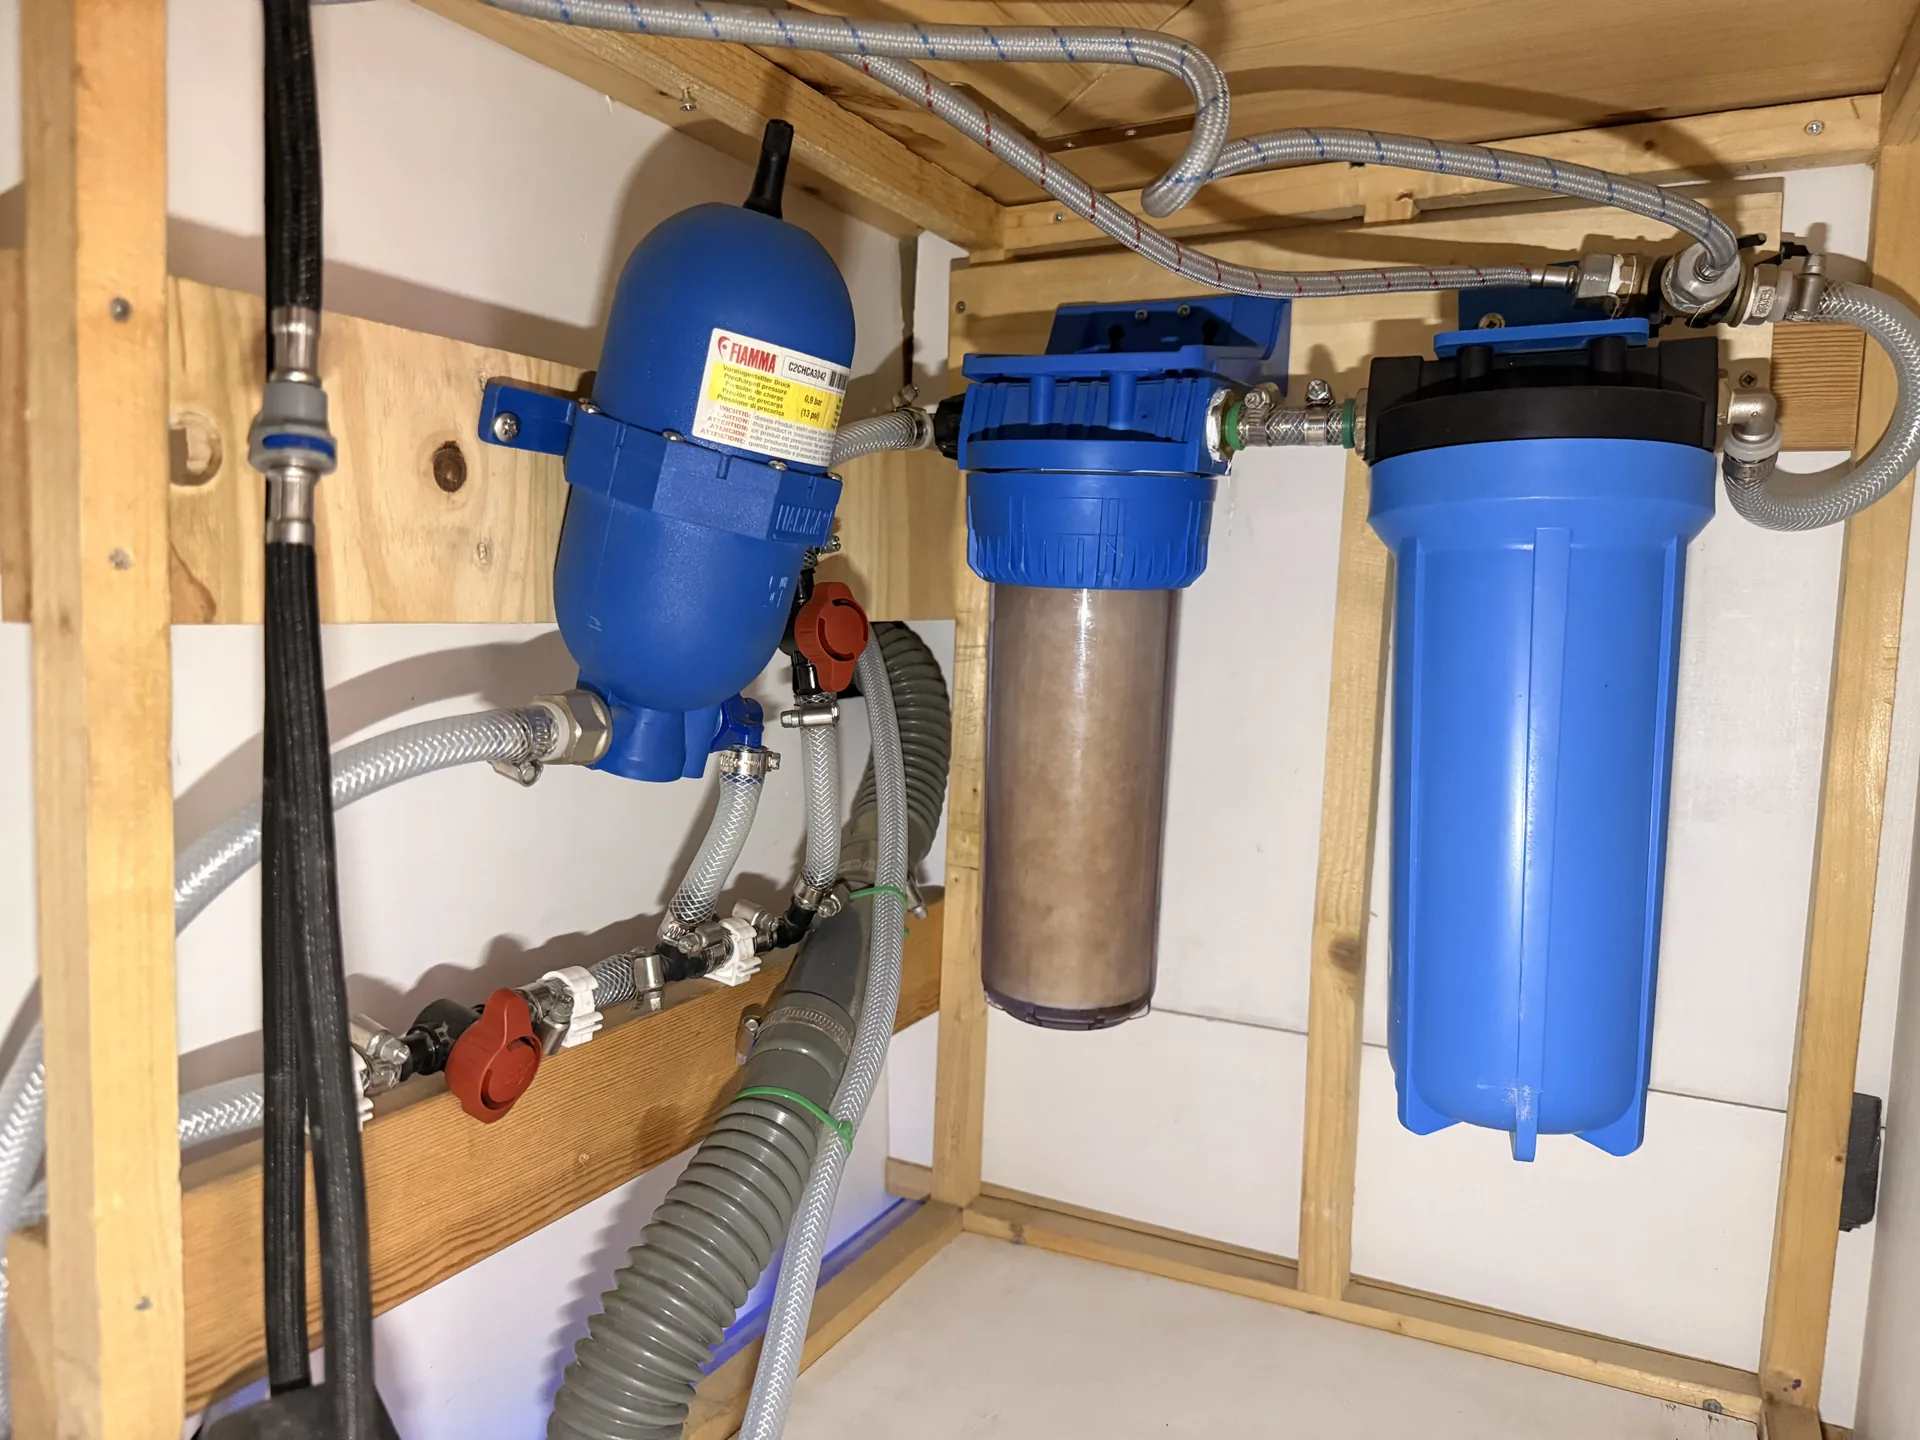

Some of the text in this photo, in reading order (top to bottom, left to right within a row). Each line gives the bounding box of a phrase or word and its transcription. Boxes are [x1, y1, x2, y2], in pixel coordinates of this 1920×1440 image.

[730, 342, 777, 374] FIAMMA
[724, 372, 787, 396] Precharged pressure
[725, 381, 752, 393] Pression
[763, 391, 784, 402] charge
[774, 379, 791, 389] Druck
[717, 393, 749, 407] Pressione
[750, 402, 757, 410] di
[748, 394, 756, 402] de
[756, 398, 783, 410] precarga
[804, 394, 823, 407] 0,9 bar
[719, 405, 751, 419] WICHTIG:
[800, 408, 820, 423] (13 psi)
[707, 416, 748, 432] ATTENTION:
[717, 412, 750, 425] CAUTION:
[764, 424, 787, 435] product
